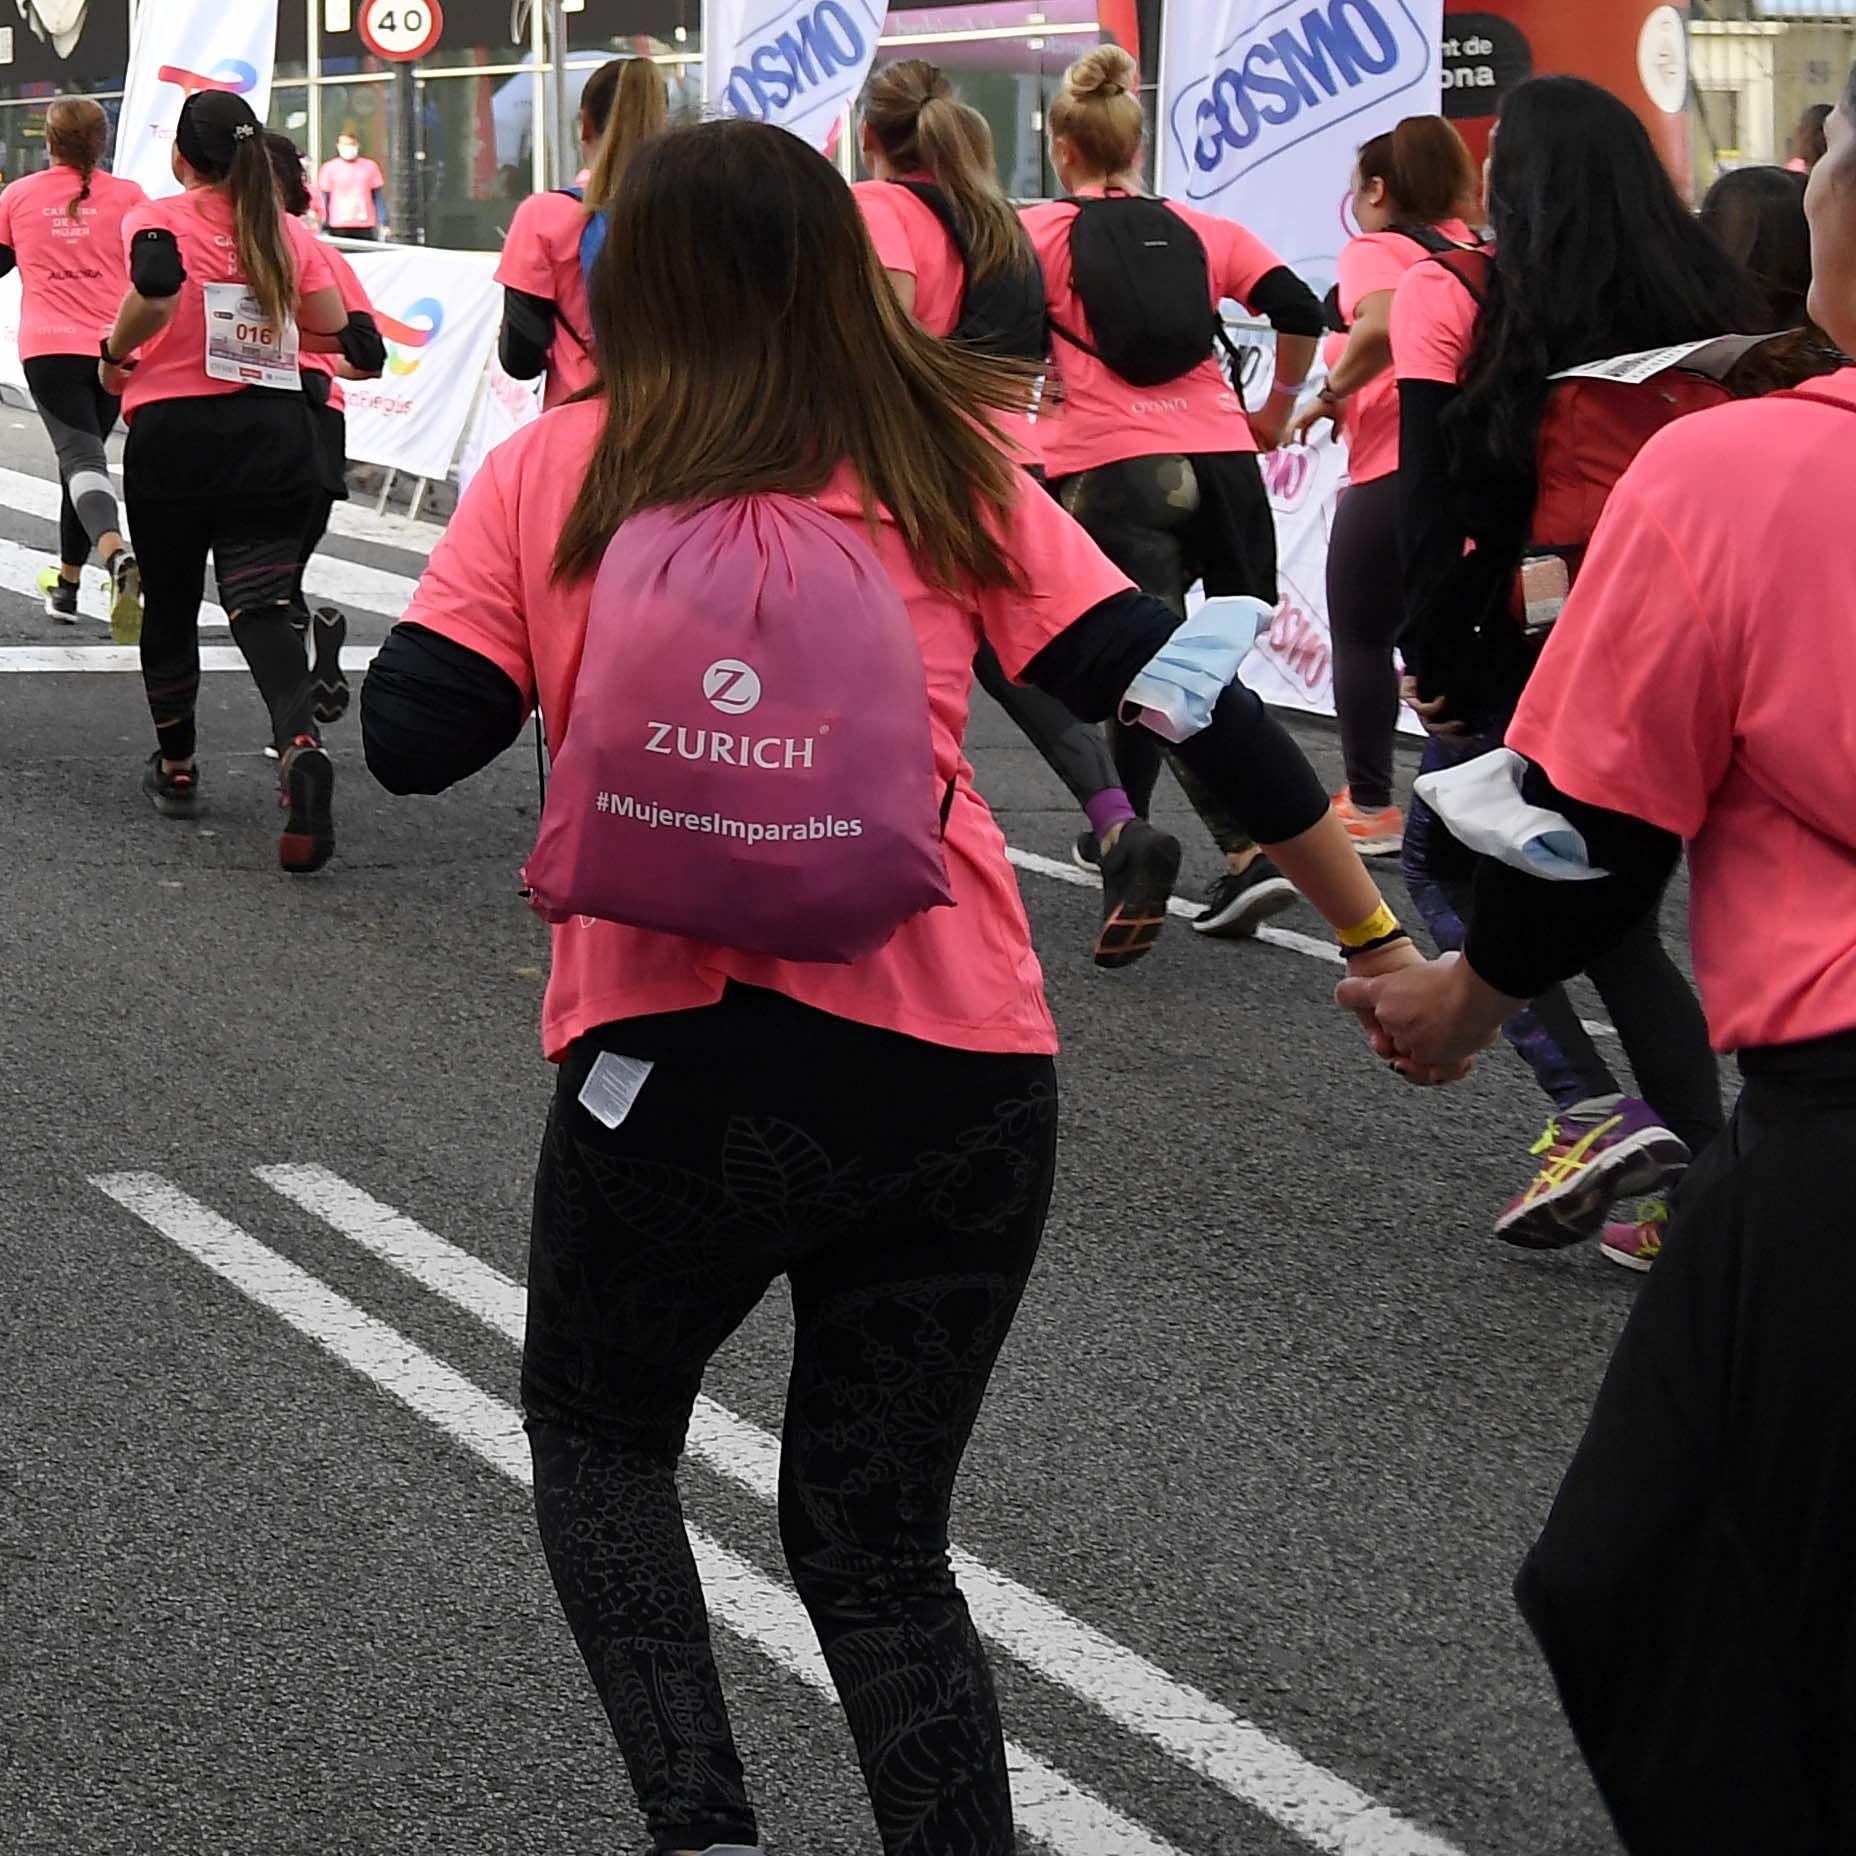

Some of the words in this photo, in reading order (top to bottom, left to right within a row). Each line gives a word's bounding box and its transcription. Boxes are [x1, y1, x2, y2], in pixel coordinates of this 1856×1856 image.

[377, 10, 422, 32] 40
[644, 721, 814, 769] ZURICH
[596, 791, 863, 845] #MujeresImparables
